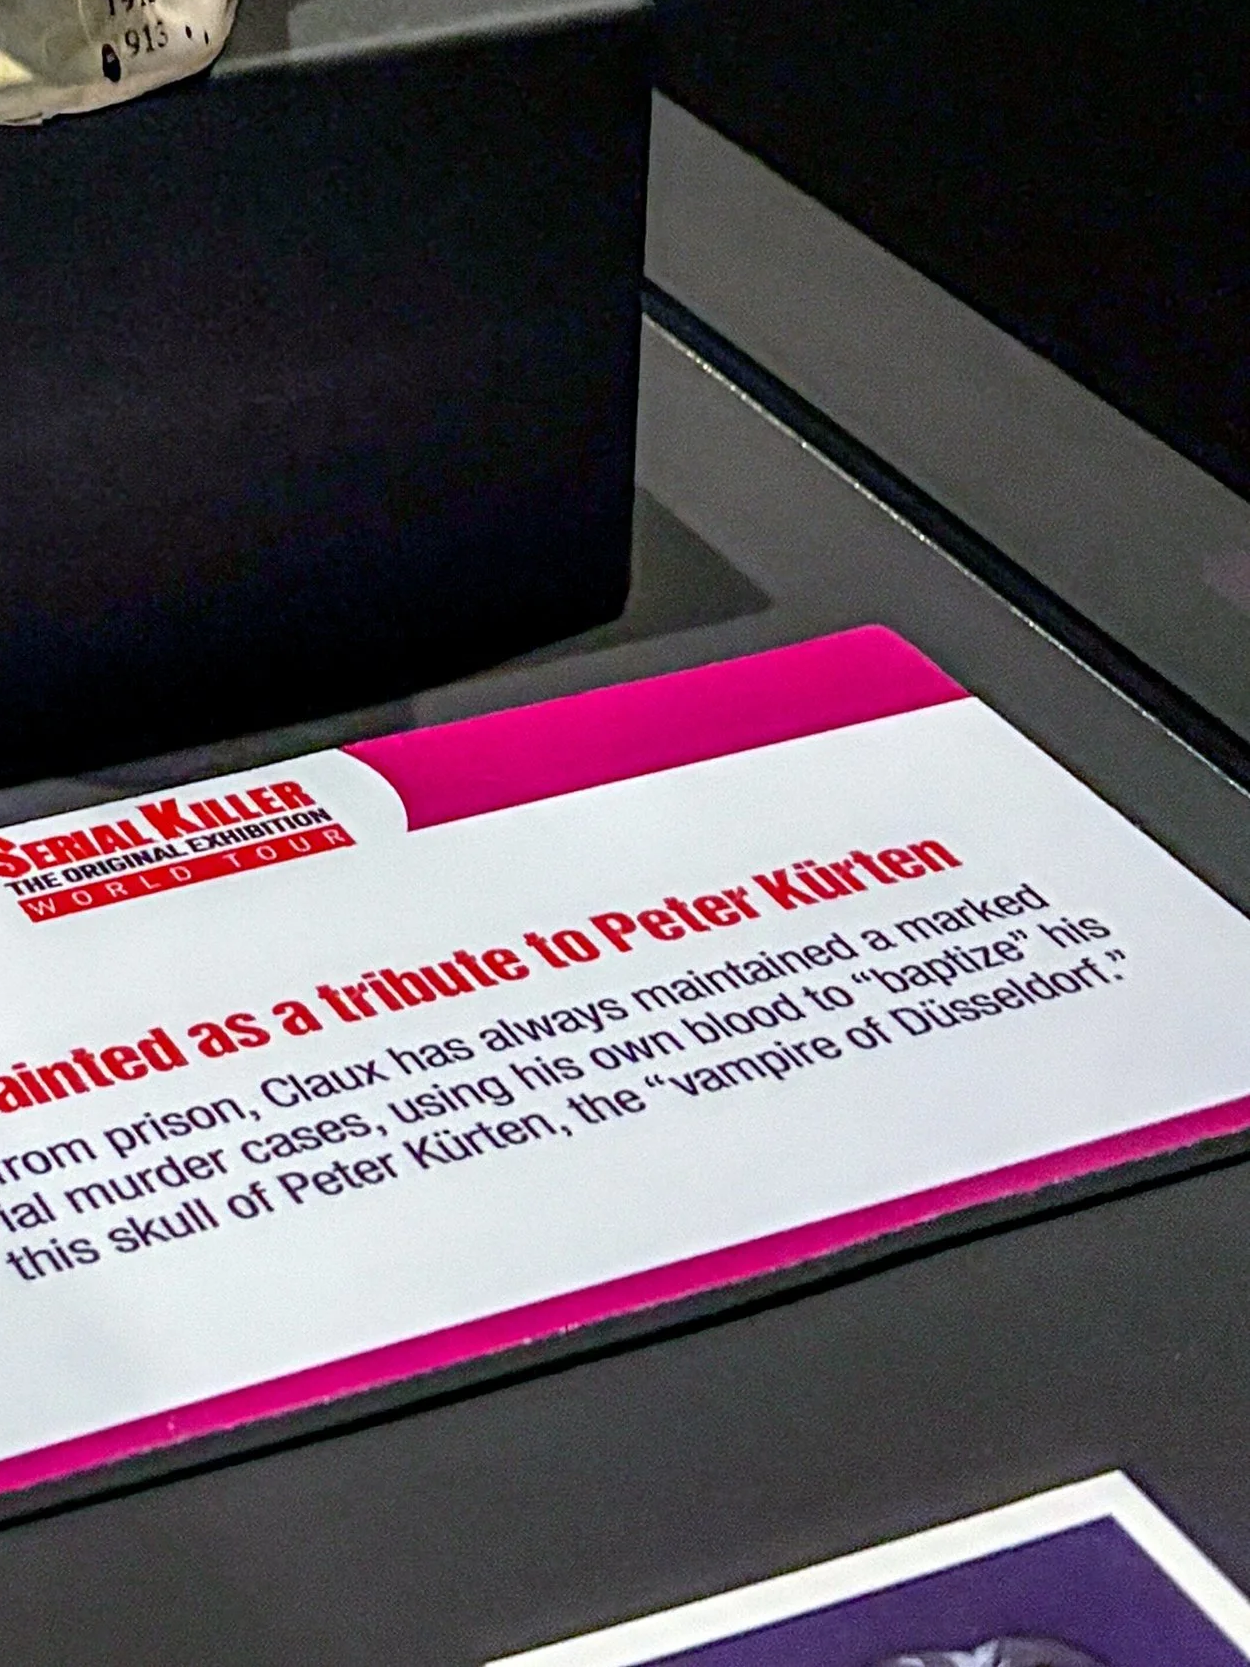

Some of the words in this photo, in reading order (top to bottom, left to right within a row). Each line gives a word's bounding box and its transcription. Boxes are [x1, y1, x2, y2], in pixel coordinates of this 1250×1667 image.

[118, 20, 169, 57] 913
[4, 874, 63, 897] THE
[63, 843, 190, 884] ORIGINAL
[187, 807, 333, 855] EXHIBITION
[27, 866, 192, 917] WORLD
[222, 827, 347, 869] TOUR
[136, 780, 317, 840] KILLER
[103, 1098, 261, 1159] prison,
[260, 1059, 390, 1108] Claux
[385, 1038, 475, 1075] has
[479, 998, 629, 1052] always
[631, 932, 860, 1012] maintained
[860, 929, 898, 952] a
[894, 882, 1050, 943] marked
[187, 1012, 271, 1059] as
[271, 1000, 324, 1036] a
[315, 948, 530, 1023] tribute
[522, 929, 601, 969] to
[589, 886, 761, 953] Peter
[751, 840, 963, 911] Kürten
[64, 1148, 228, 1214] murder
[240, 1113, 388, 1164] cases,
[387, 1076, 515, 1124] using
[508, 1056, 585, 1091] his
[589, 1031, 686, 1070] own
[680, 992, 807, 1045] blood
[802, 985, 855, 1012] to
[1037, 917, 1111, 949] his
[6, 1238, 101, 1281] this
[107, 1198, 220, 1253] skull
[227, 1180, 275, 1219] of
[276, 1153, 398, 1205] Peter
[402, 1114, 573, 1170] Kürten,
[566, 1089, 646, 1124] the
[845, 1015, 893, 1050] of
